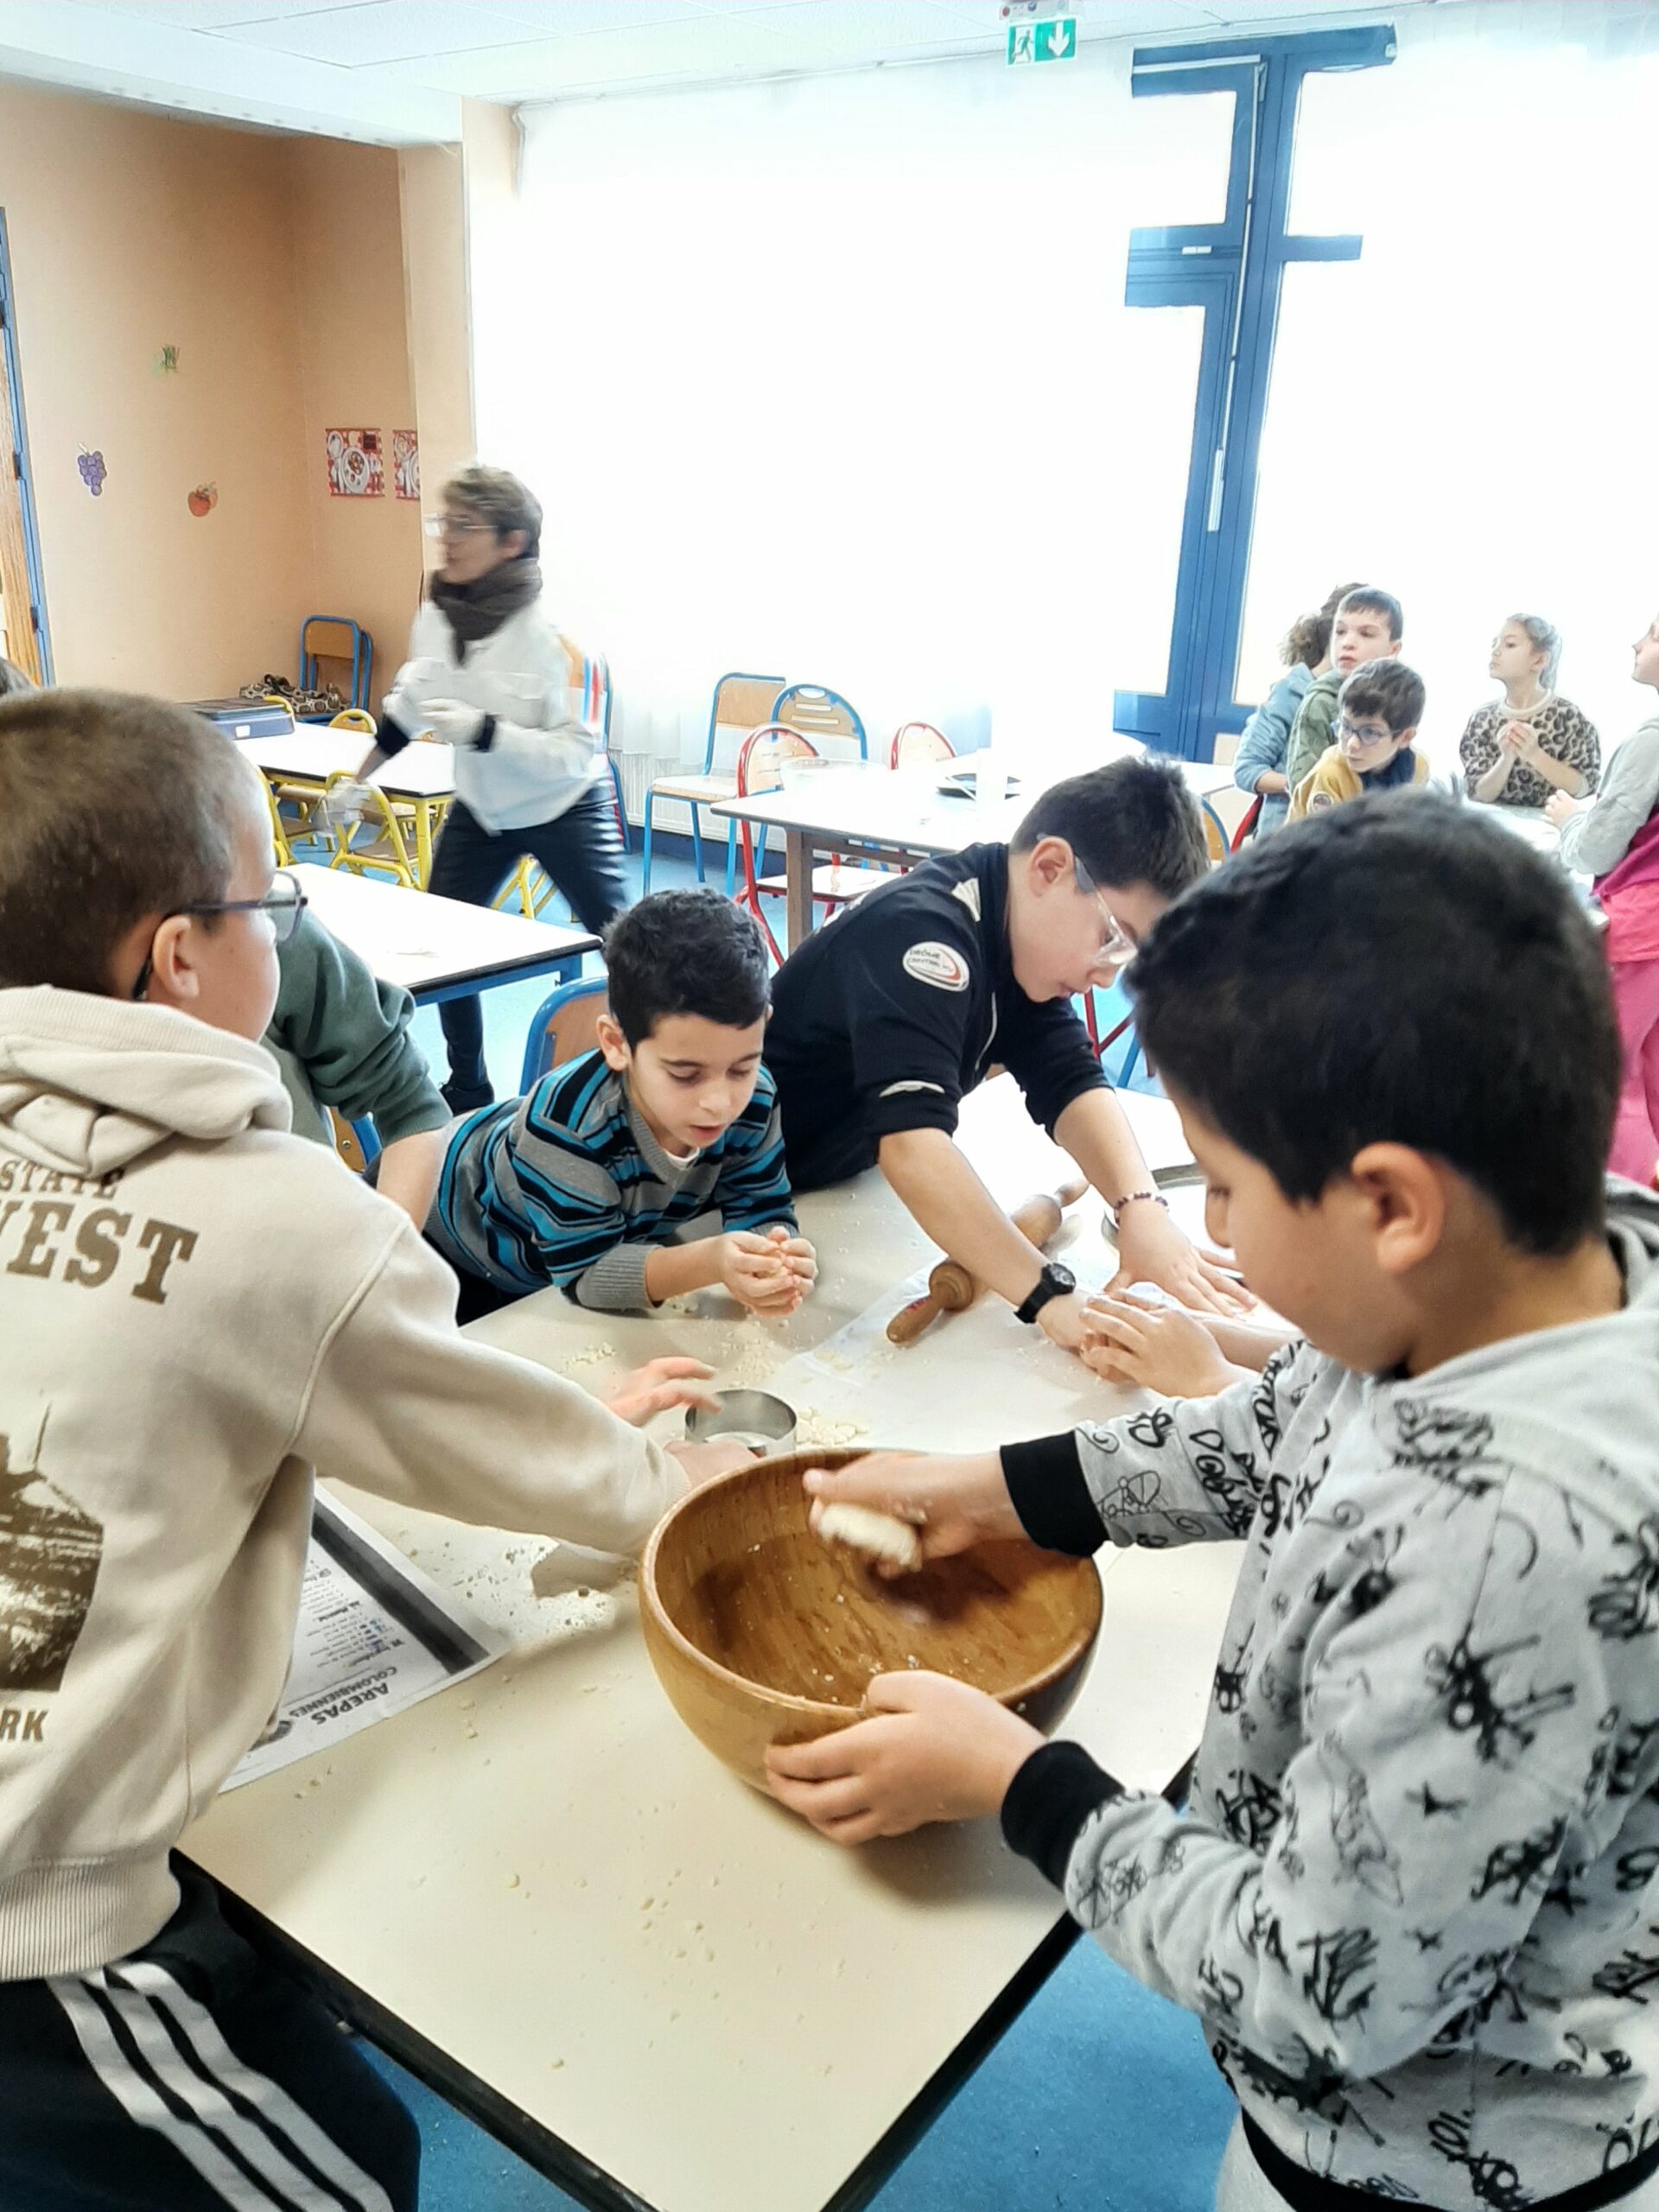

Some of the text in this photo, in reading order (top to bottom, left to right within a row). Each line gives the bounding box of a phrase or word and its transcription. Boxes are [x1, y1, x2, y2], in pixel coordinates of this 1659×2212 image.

[0, 1199, 200, 1305] EST
[289, 1667, 397, 1717] COLOMBIENNES
[311, 1682, 389, 1725] AREPAS
